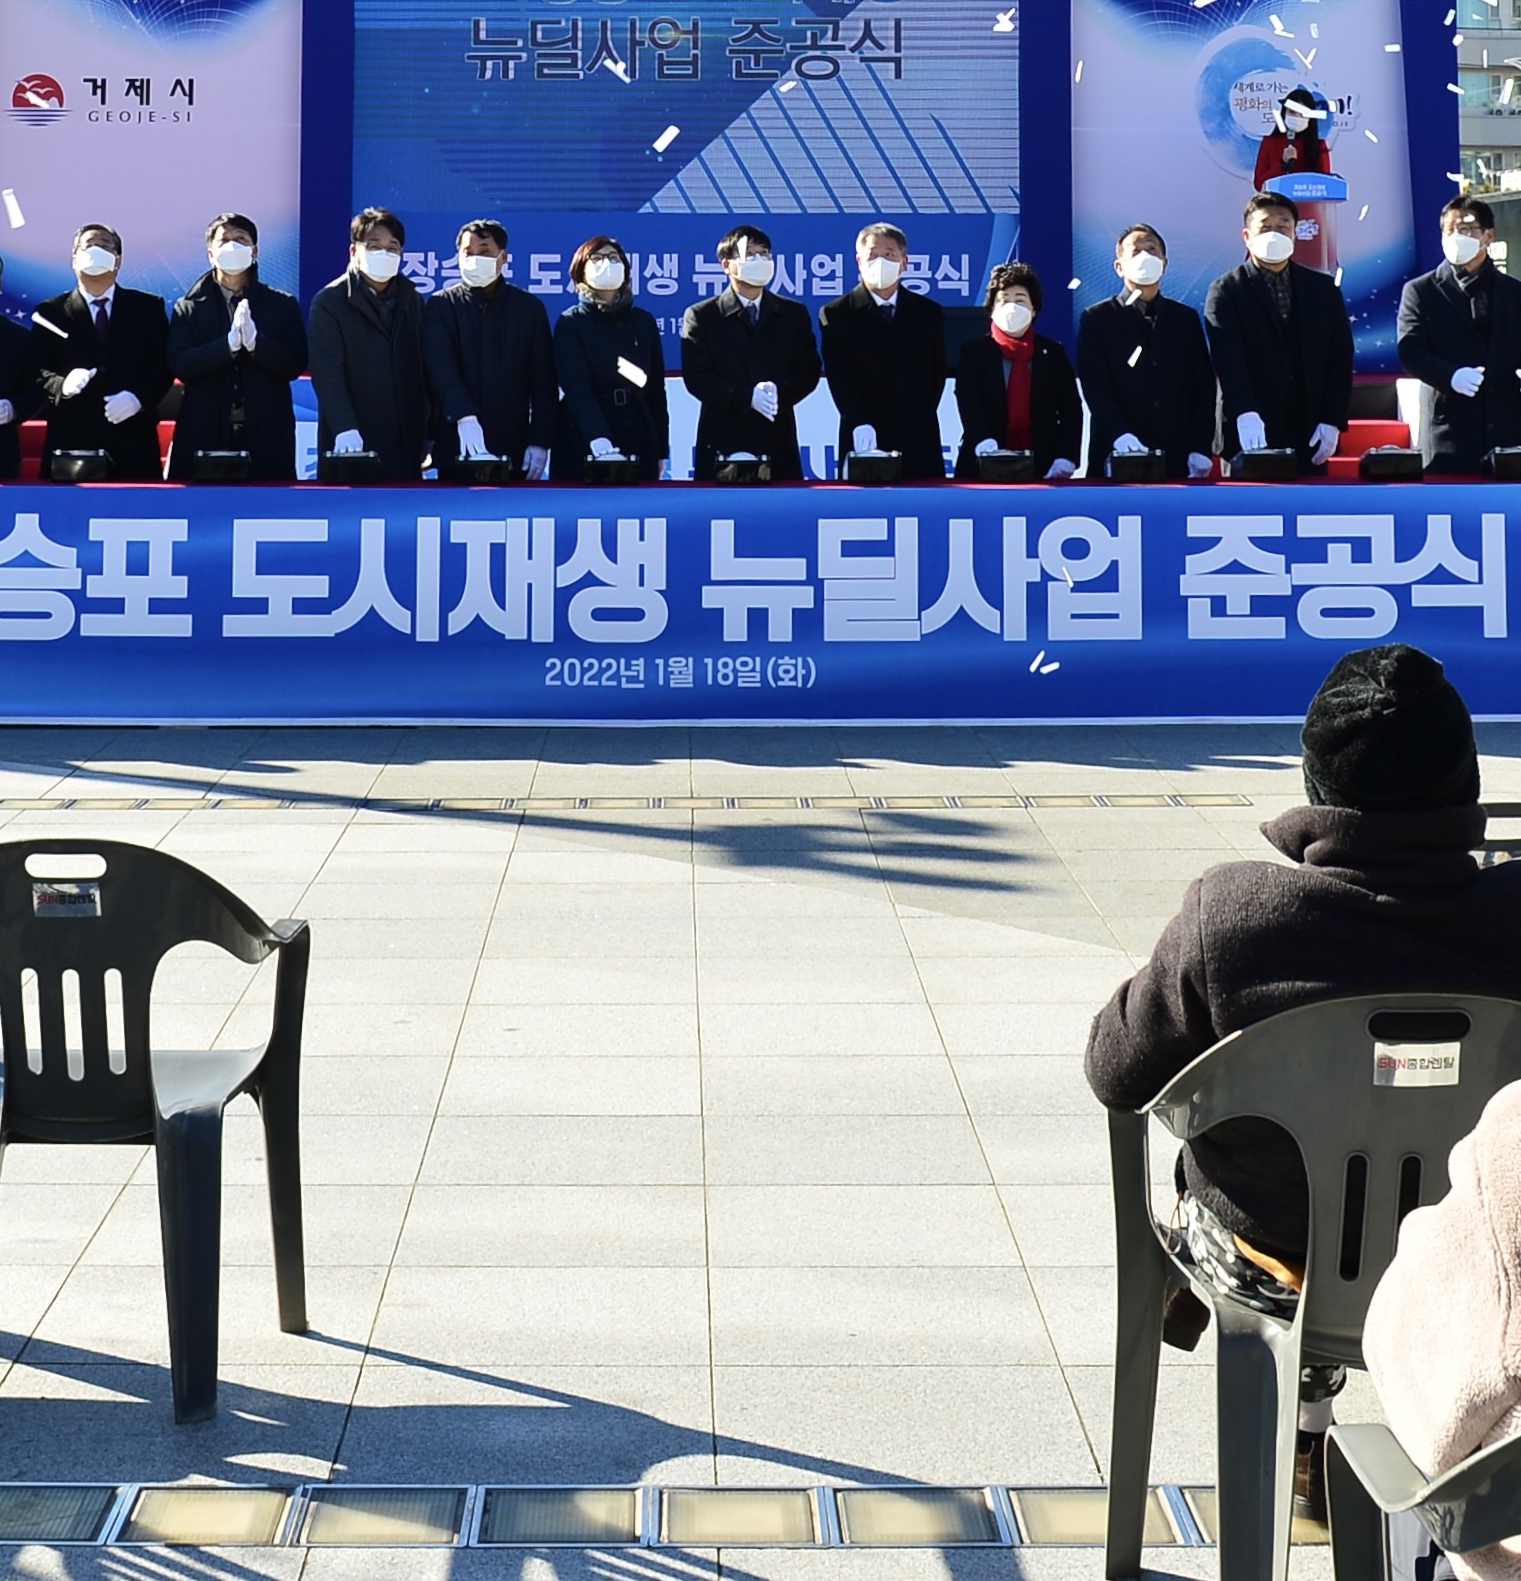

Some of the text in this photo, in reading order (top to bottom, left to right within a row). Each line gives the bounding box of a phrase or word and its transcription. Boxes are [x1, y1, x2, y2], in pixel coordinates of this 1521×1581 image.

[464, 16, 905, 81] 뉴딜사업 준공식
[83, 78, 195, 106] 거제시
[1234, 97, 1272, 111] 평화의
[88, 111, 191, 124] GEOJE-SI
[402, 252, 512, 293] 장승
[693, 253, 843, 296] 뉴사업
[861, 252, 969, 296] 공식
[222, 515, 669, 644] 도시재생
[700, 514, 1143, 643] 뉴딜사업
[1179, 513, 1508, 640] 준공식
[544, 656, 644, 688] 2022년
[655, 657, 693, 687] 1월
